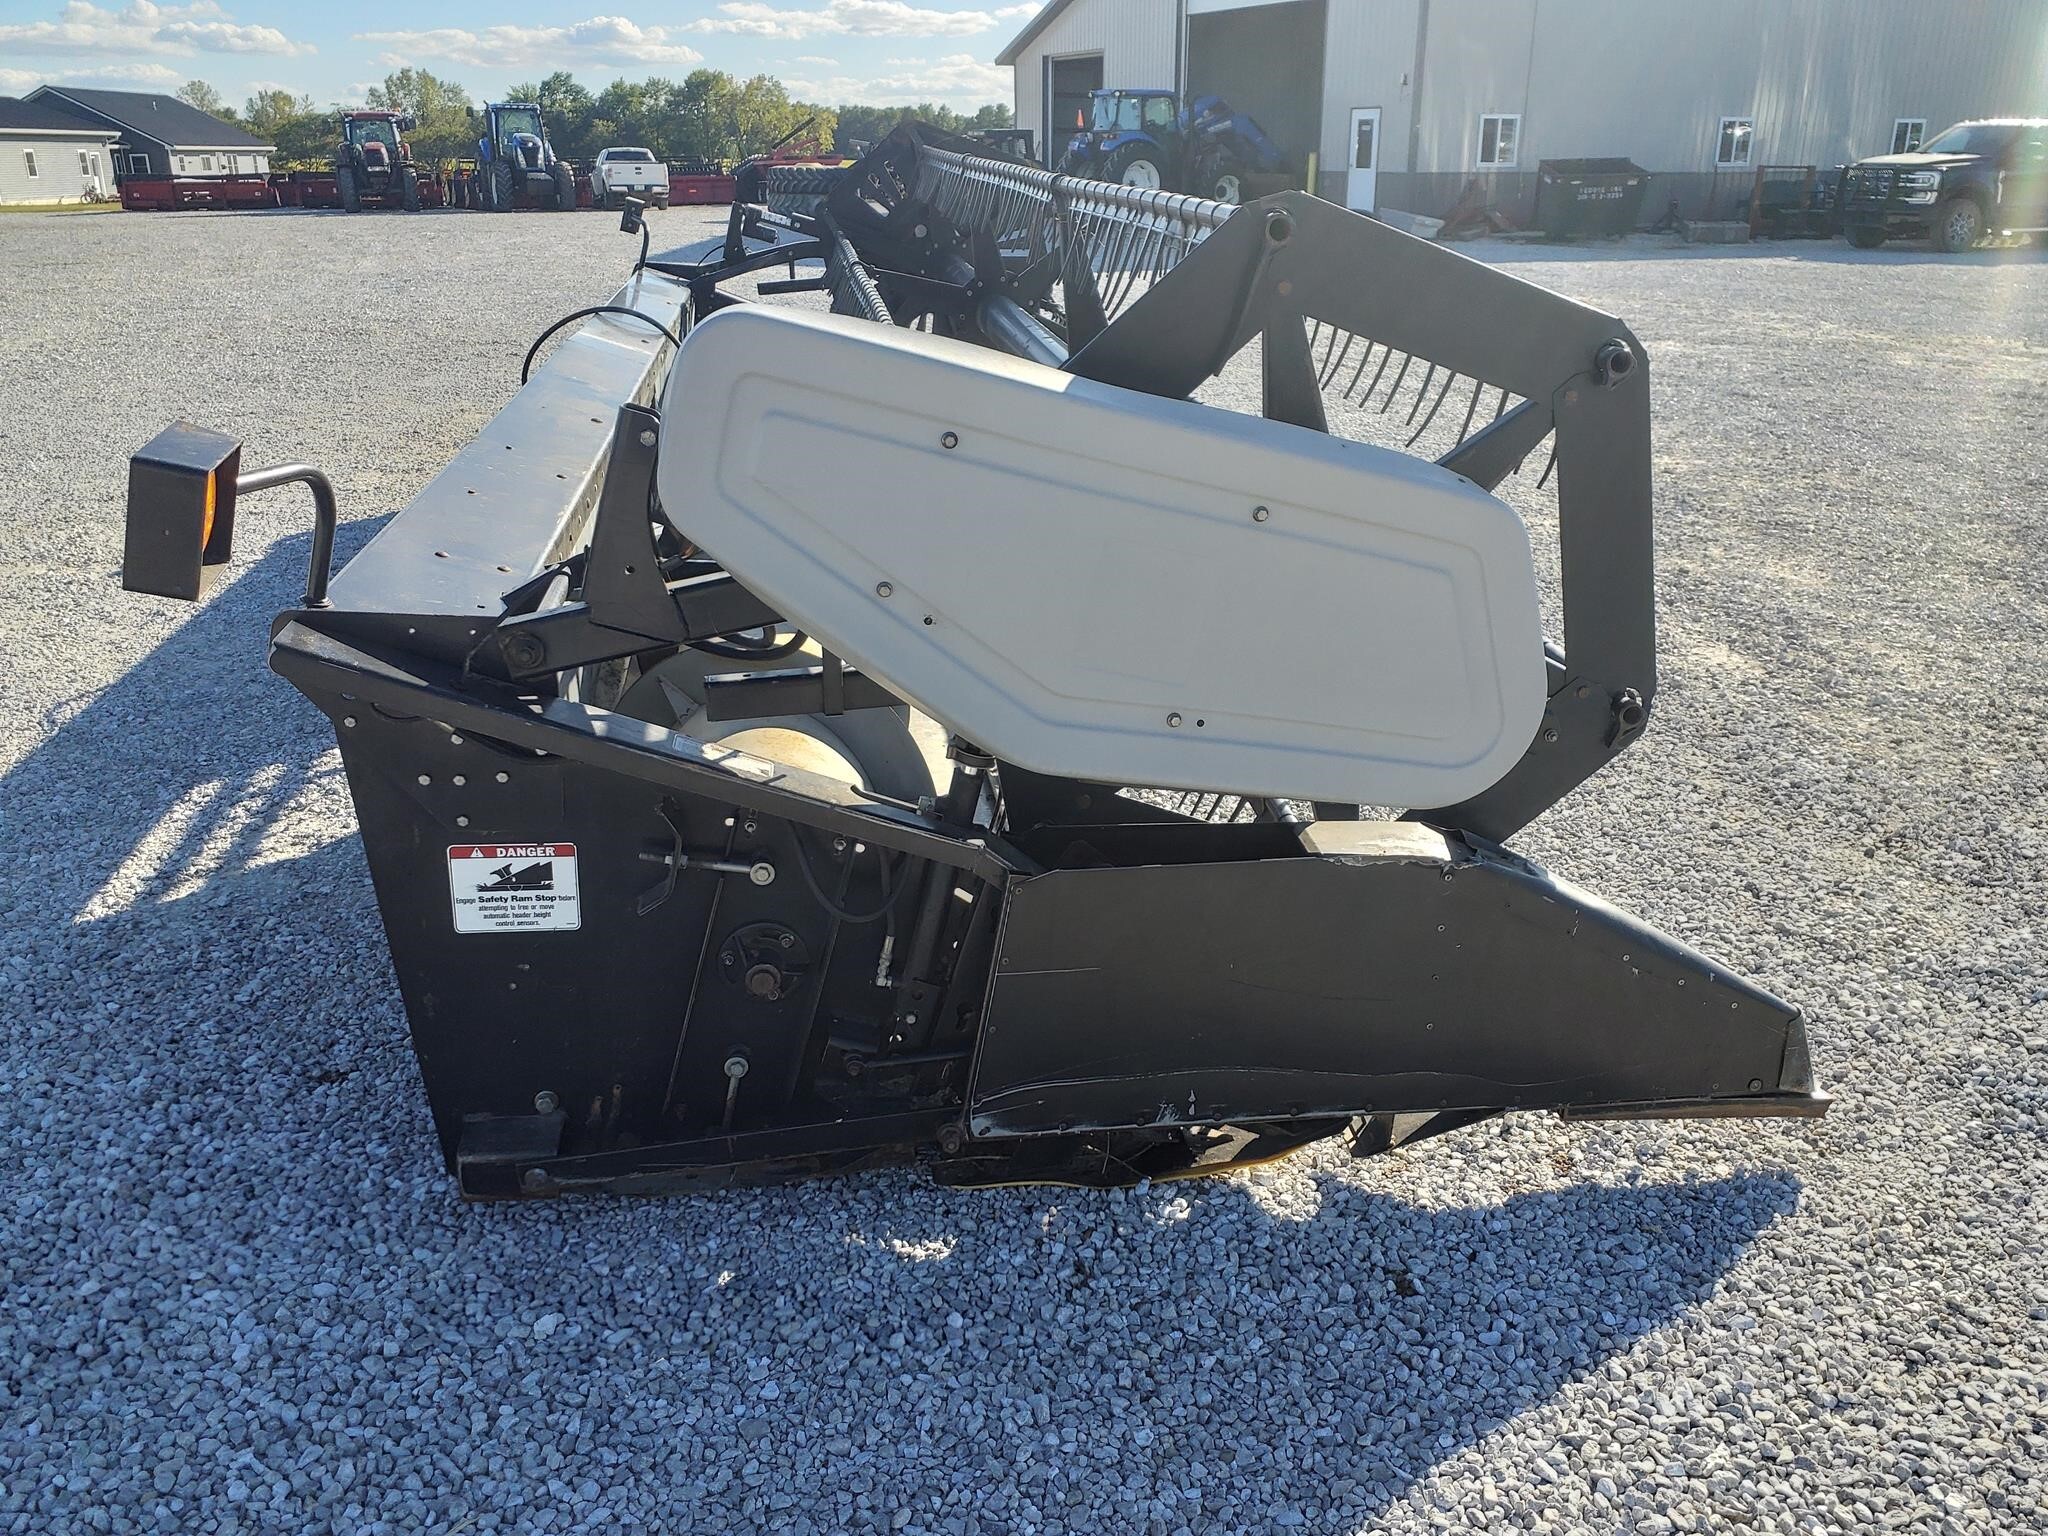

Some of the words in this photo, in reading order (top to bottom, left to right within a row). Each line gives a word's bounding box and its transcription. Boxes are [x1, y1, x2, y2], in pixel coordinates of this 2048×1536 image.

[496, 847, 556, 857] DANGER
[478, 895, 509, 903] Safety
[535, 894, 557, 903] Stop
[495, 919, 516, 927] control
